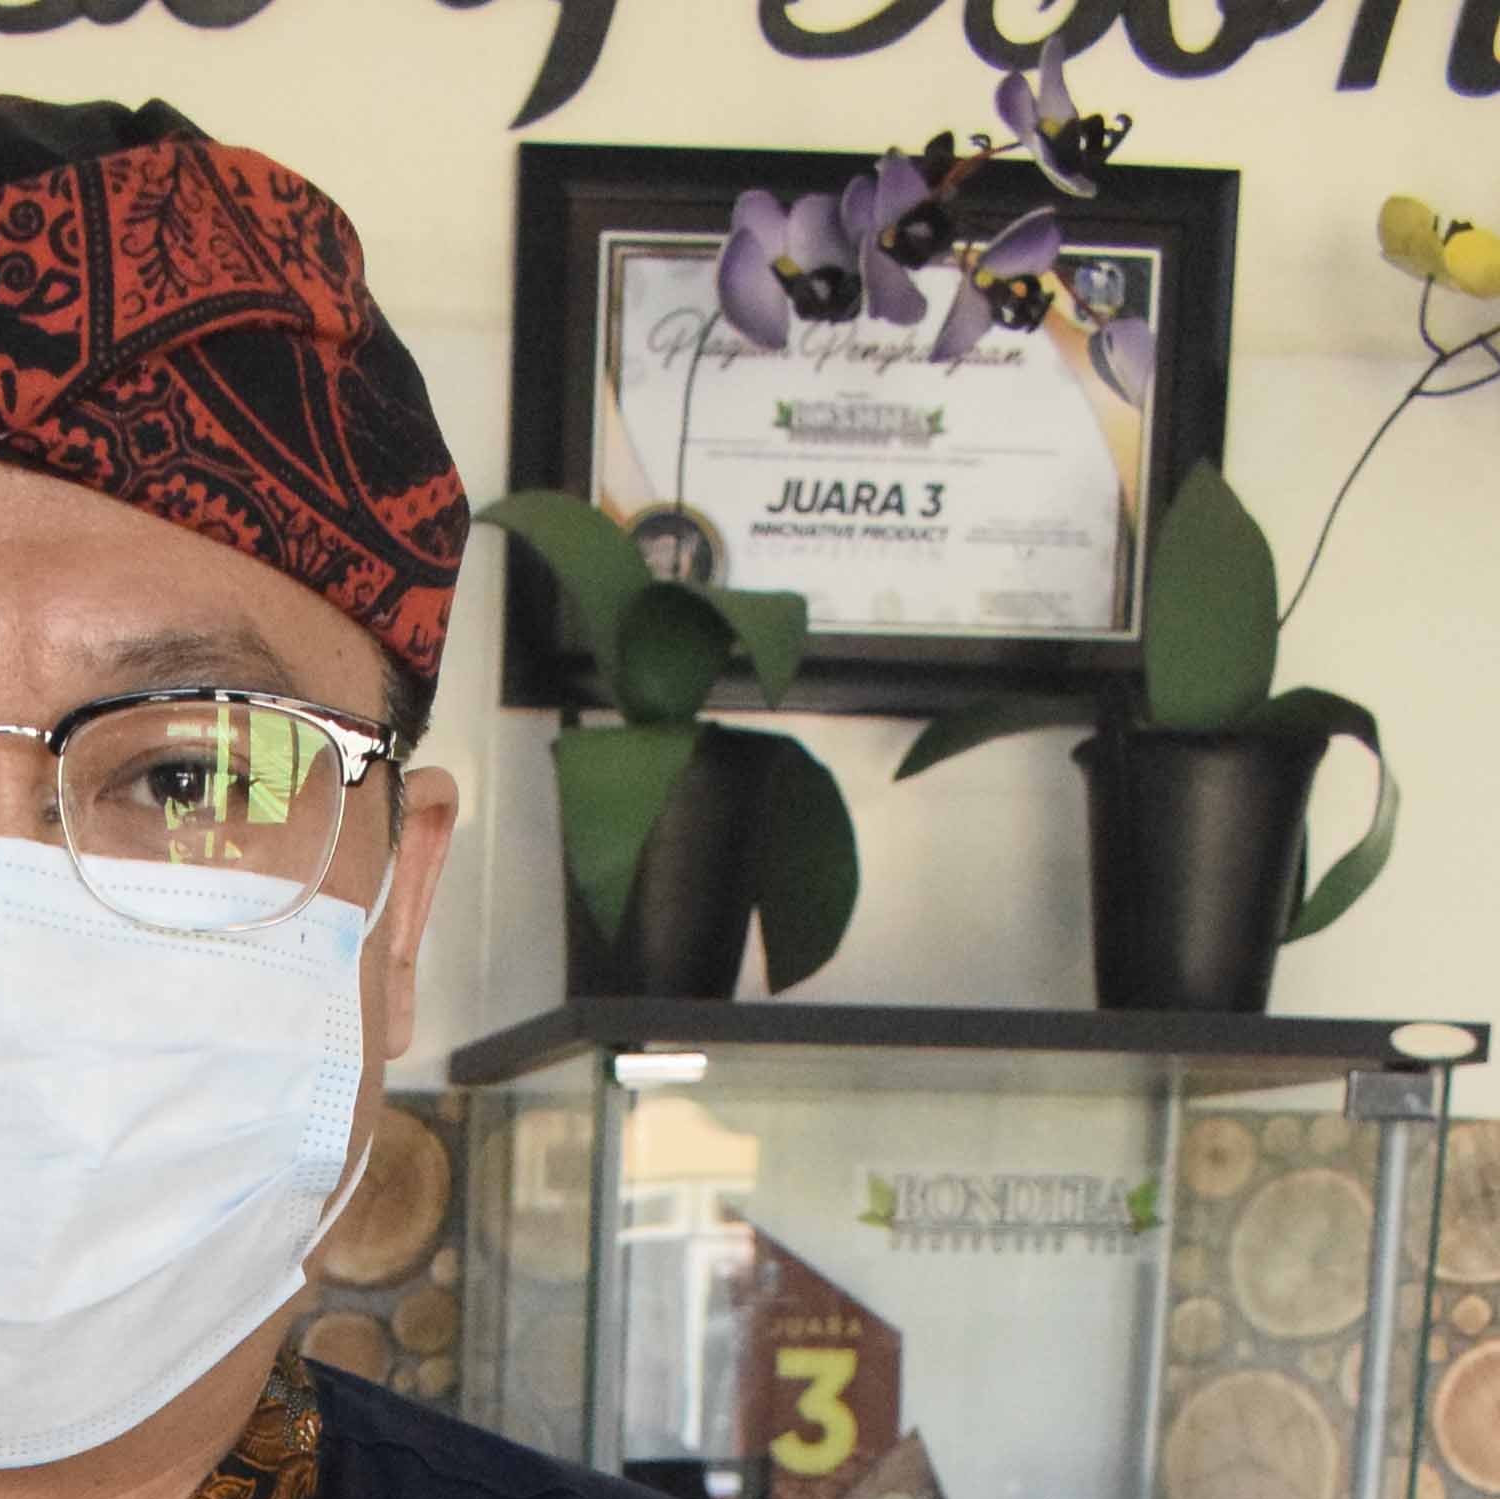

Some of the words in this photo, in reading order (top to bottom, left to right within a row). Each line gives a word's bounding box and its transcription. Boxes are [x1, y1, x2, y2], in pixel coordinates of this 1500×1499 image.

[766, 480, 905, 516] JUARA
[920, 483, 946, 517] 3
[750, 522, 856, 539] INNOVATIVE
[861, 525, 949, 543] PRODUCT
[770, 1347, 859, 1475] 3
